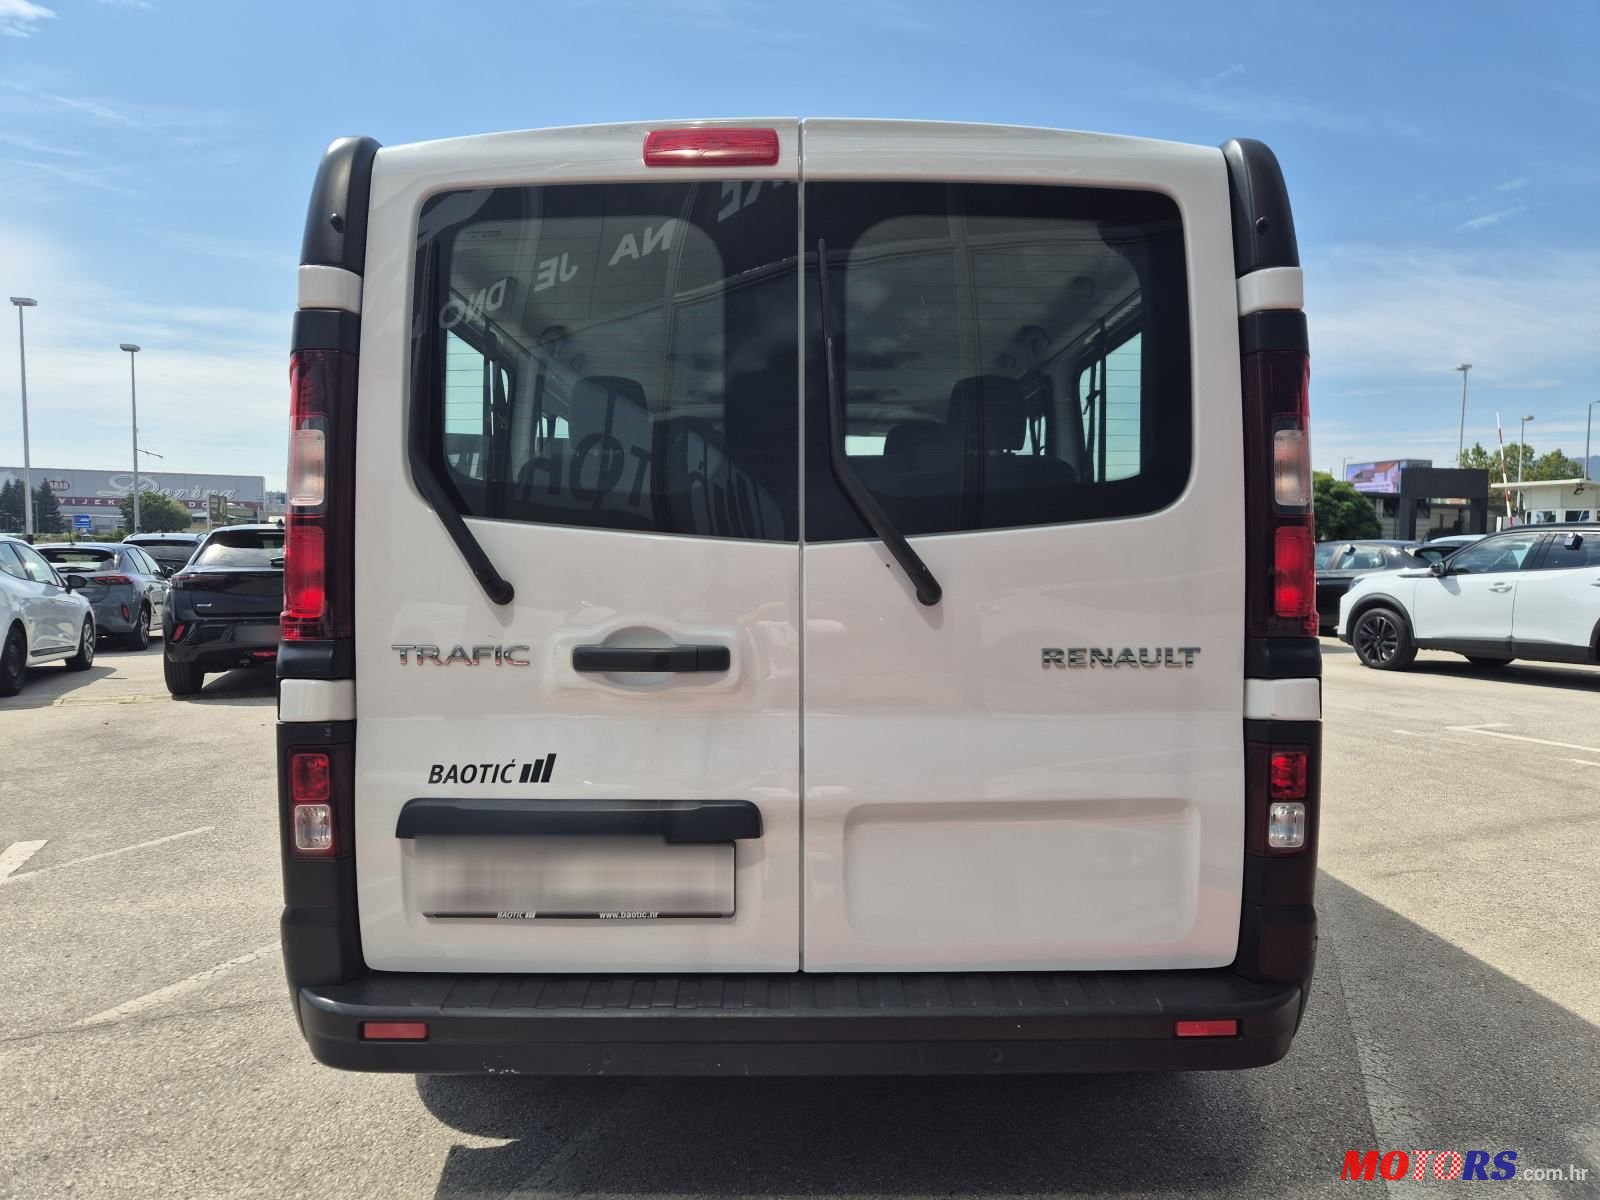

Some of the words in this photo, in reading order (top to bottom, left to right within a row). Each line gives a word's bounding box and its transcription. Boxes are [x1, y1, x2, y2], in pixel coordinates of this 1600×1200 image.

[96, 474, 239, 500] Dorina
[391, 644, 530, 666] TRAFIC
[1041, 647, 1201, 669] RENAULT
[428, 759, 516, 784] BAOTIĆ
